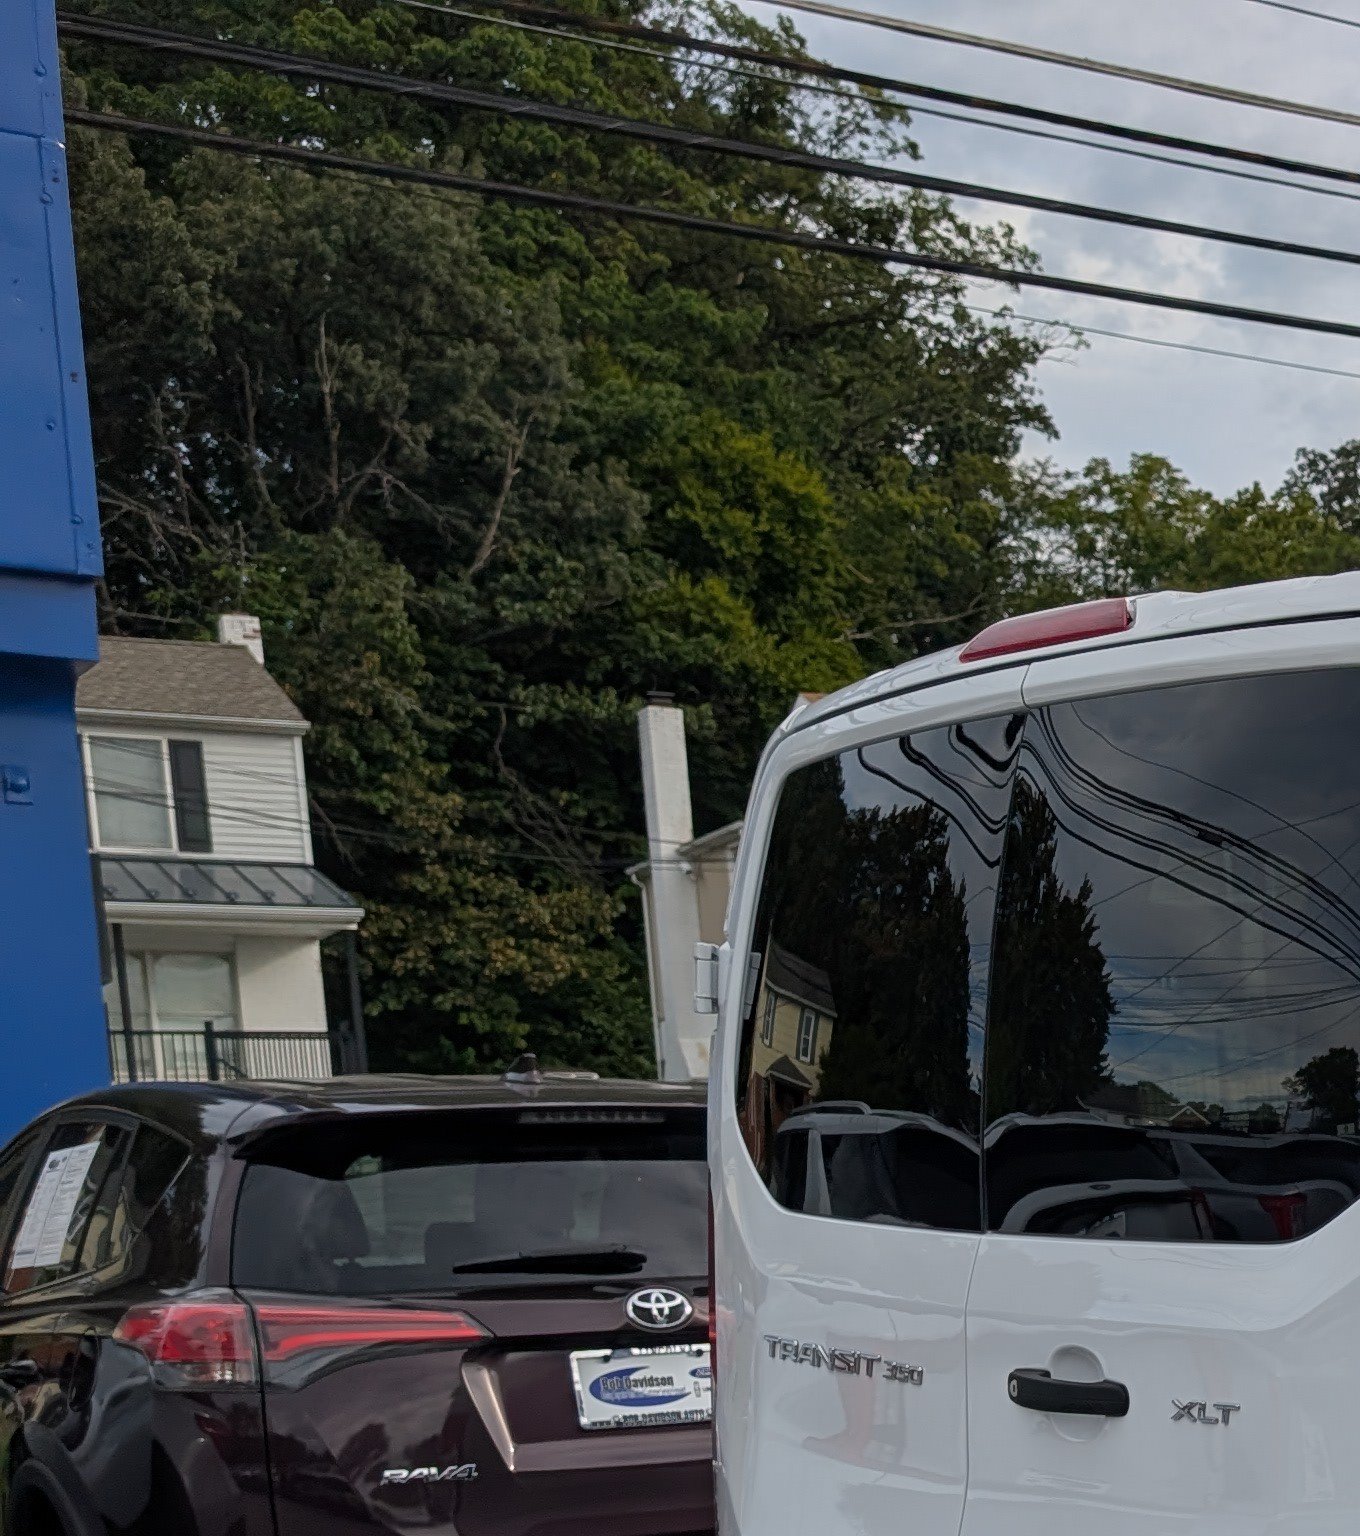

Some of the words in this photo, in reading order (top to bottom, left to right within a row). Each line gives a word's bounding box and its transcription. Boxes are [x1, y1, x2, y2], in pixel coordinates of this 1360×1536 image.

[764, 1335, 881, 1377] TRANSIT
[882, 1360, 923, 1385] 350
[602, 1378, 621, 1392] Bob
[624, 1376, 674, 1390] Davidson
[1171, 1399, 1241, 1426] XLT
[380, 1463, 479, 1486] RAV4
